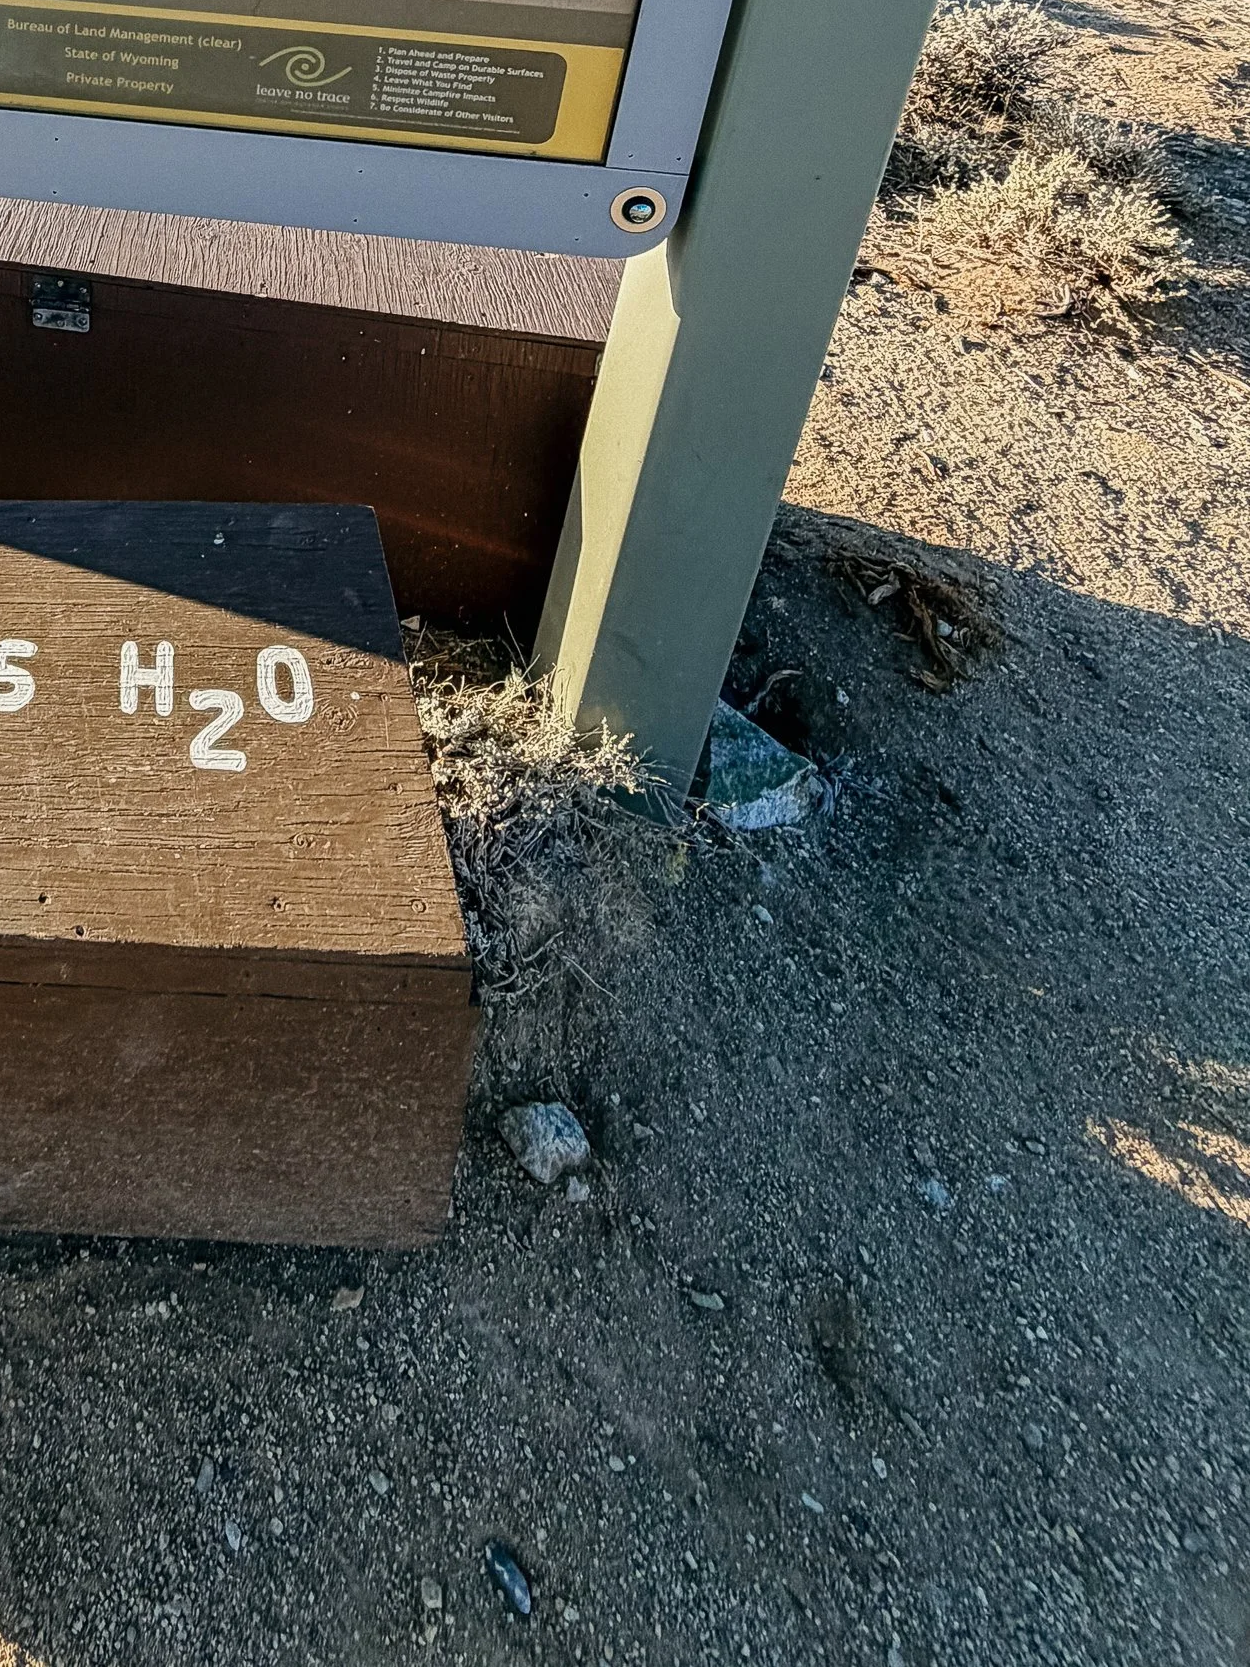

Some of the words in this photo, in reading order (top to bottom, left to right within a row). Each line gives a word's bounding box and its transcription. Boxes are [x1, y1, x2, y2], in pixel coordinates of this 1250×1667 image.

[7, 19, 52, 33] Bureau
[57, 23, 70, 34] of
[74, 25, 106, 37] Land
[110, 28, 193, 46] Management
[198, 37, 242, 51] (clear)
[64, 47, 98, 60] State
[102, 51, 115, 61] of
[120, 53, 179, 69] Wyoming
[408, 50, 435, 58] Ahead
[455, 54, 489, 63] Prepare
[375, 65, 382, 73] 3.
[386, 66, 417, 76] Dispose
[431, 71, 456, 79] Waste
[458, 73, 495, 84] Properly
[388, 57, 412, 65] Travel
[433, 61, 456, 70] Camp
[472, 65, 505, 74] Durable
[507, 68, 544, 78] Surfaces
[67, 73, 112, 87] Private
[116, 77, 173, 94] Property
[384, 76, 409, 84] Leave
[412, 79, 433, 87] What
[453, 82, 472, 90] Find
[256, 84, 291, 98] leave
[295, 90, 312, 99] no
[317, 92, 350, 103] trace
[381, 94, 414, 104] Respect
[417, 98, 448, 107] Wildlife
[383, 86, 421, 95] Minimize
[423, 89, 461, 98] Campfire
[463, 93, 495, 102] Impacts
[370, 102, 377, 110] 7.
[393, 106, 442, 116] Considerate
[456, 111, 480, 119] Other
[483, 113, 513, 123] Visitors
